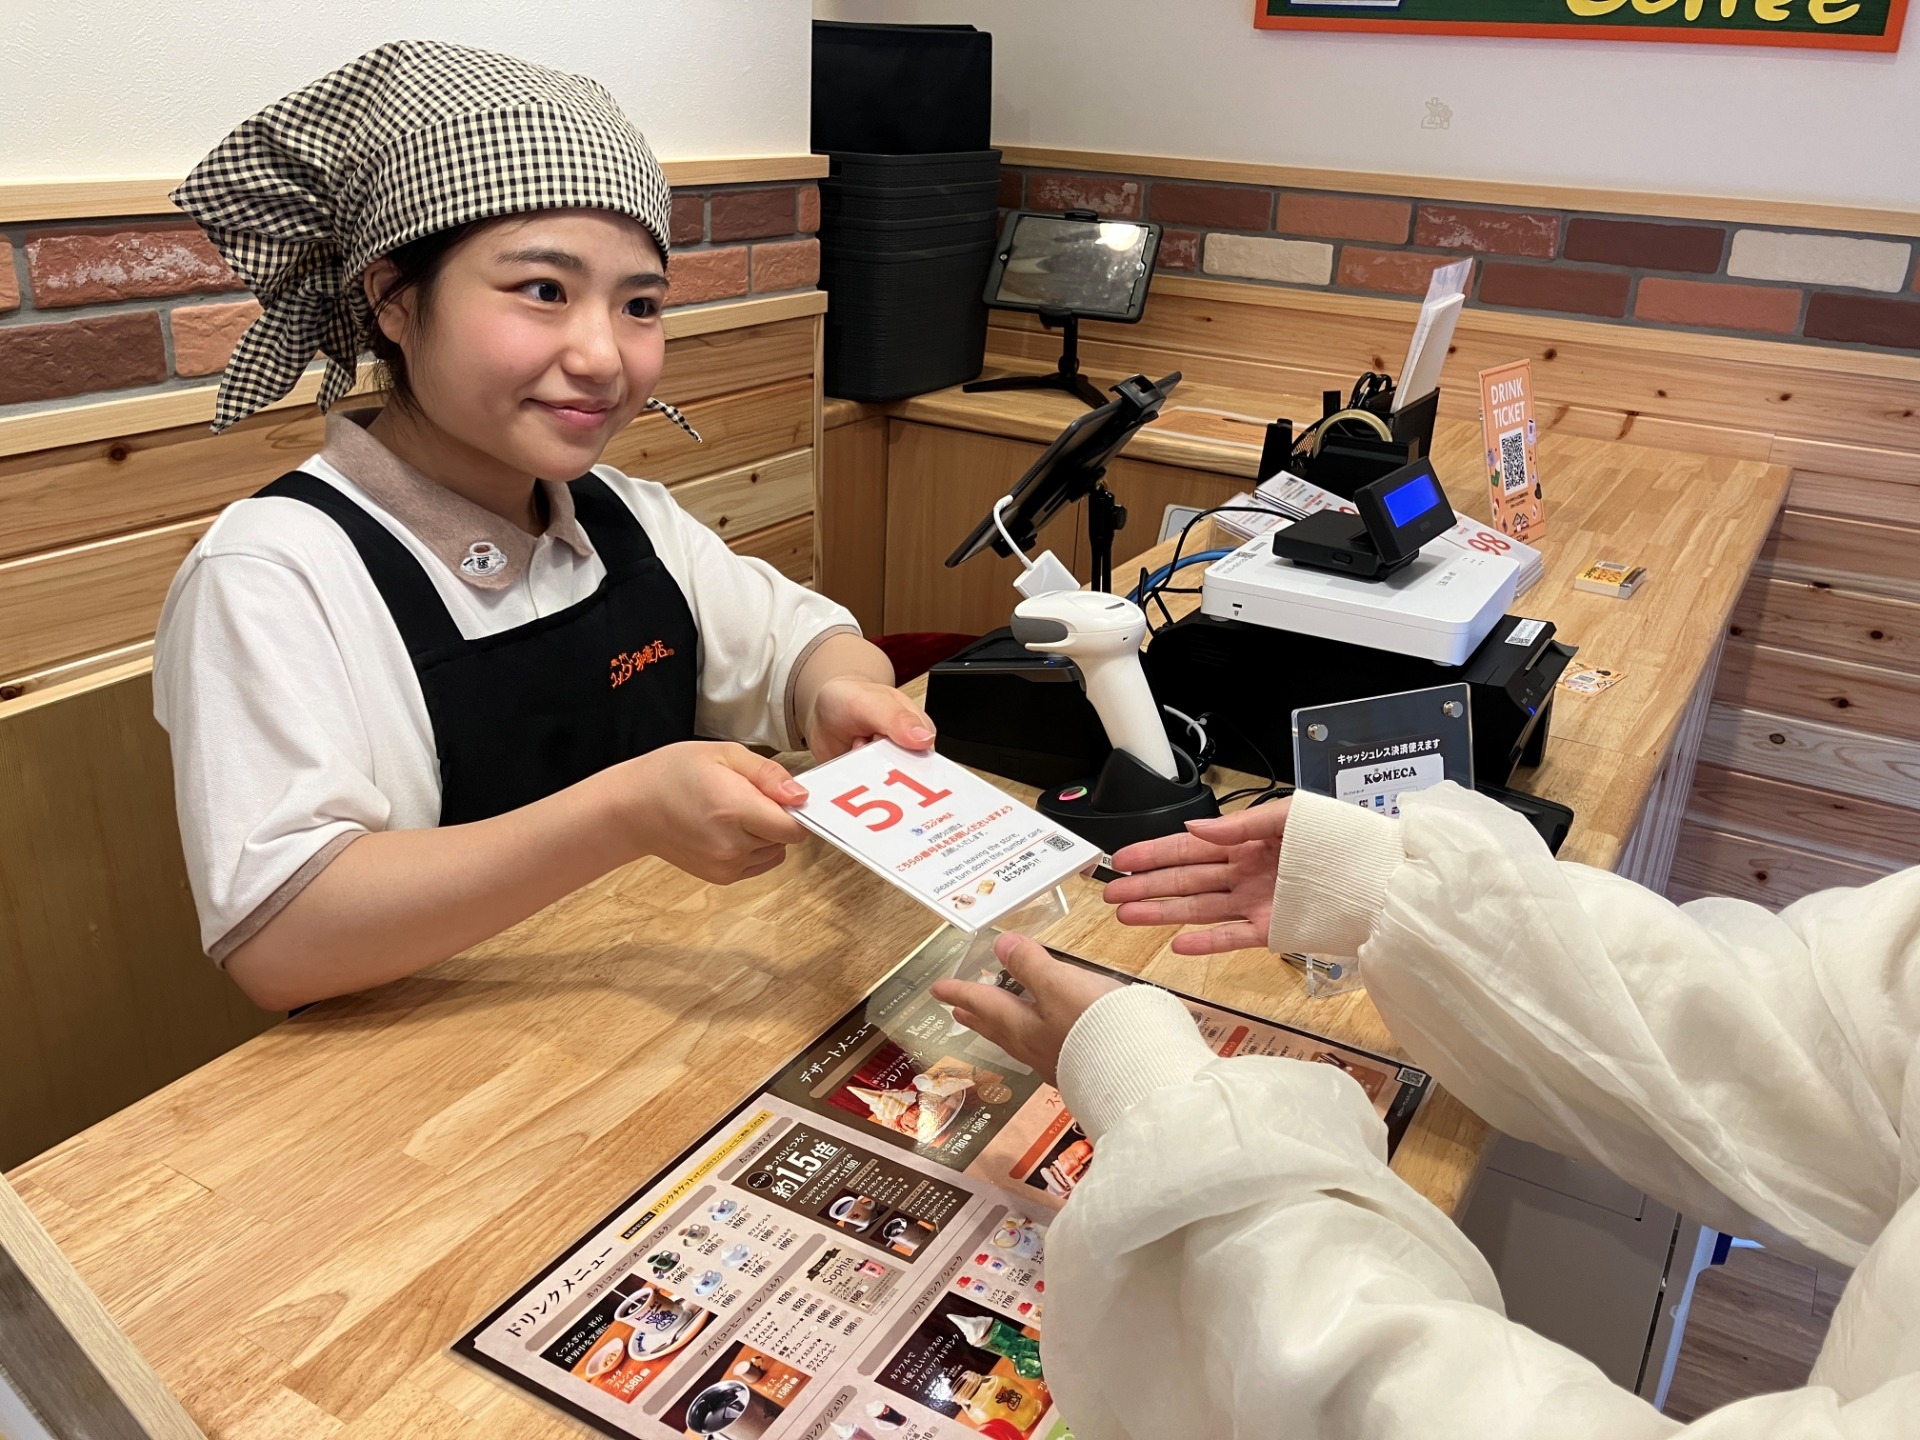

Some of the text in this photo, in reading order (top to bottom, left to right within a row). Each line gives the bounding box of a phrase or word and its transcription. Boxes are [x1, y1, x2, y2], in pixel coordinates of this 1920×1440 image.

[1490, 377, 1524, 405] DRINK
[1493, 401, 1526, 429] TICKET
[1337, 738, 1441, 765] キャッシュレス決済使えます
[1364, 766, 1418, 785] KOMECA
[830, 769, 952, 832] 51
[933, 827, 1043, 894] please turn down this number card.
[943, 833, 1020, 875] When leaving the store,
[993, 850, 1035, 877] アレルギー情報
[920, 1018, 946, 1040] neige
[799, 1021, 876, 1082] デザートメニュー
[879, 1047, 928, 1090] シロノワール
[969, 1116, 987, 1133] ¥580
[738, 1132, 773, 1163] たっぷりサイズ
[764, 1131, 808, 1171] ゆったりくつろぐ
[949, 1138, 968, 1154] ¥780
[752, 1173, 768, 1187] たっぷり
[756, 1138, 841, 1198] 約1.5倍
[724, 1205, 748, 1225] ミルクコーヒー
[697, 1232, 718, 1252] カフェオーレ
[665, 1263, 684, 1280] アメリカン
[672, 1270, 687, 1284] ¥580
[822, 1257, 854, 1285] Sophia
[505, 1247, 612, 1337] ドリンクメニュー
[776, 1290, 791, 1304] ¥620
[791, 1297, 806, 1311] ¥620
[1000, 1294, 1014, 1308] ¥700
[555, 1313, 603, 1356] くつろぎの一杯が
[564, 1322, 613, 1363] 世界中を笑顔に
[889, 1351, 915, 1379] カラフルで
[900, 1335, 943, 1385] 可愛らしいグラスの
[912, 1333, 958, 1391] コメダのソフトドリンク
[605, 1368, 622, 1384] コメダ
[613, 1368, 633, 1389] ブレンド
[621, 1374, 644, 1393] ¥580
[775, 1382, 794, 1398] ¥580
